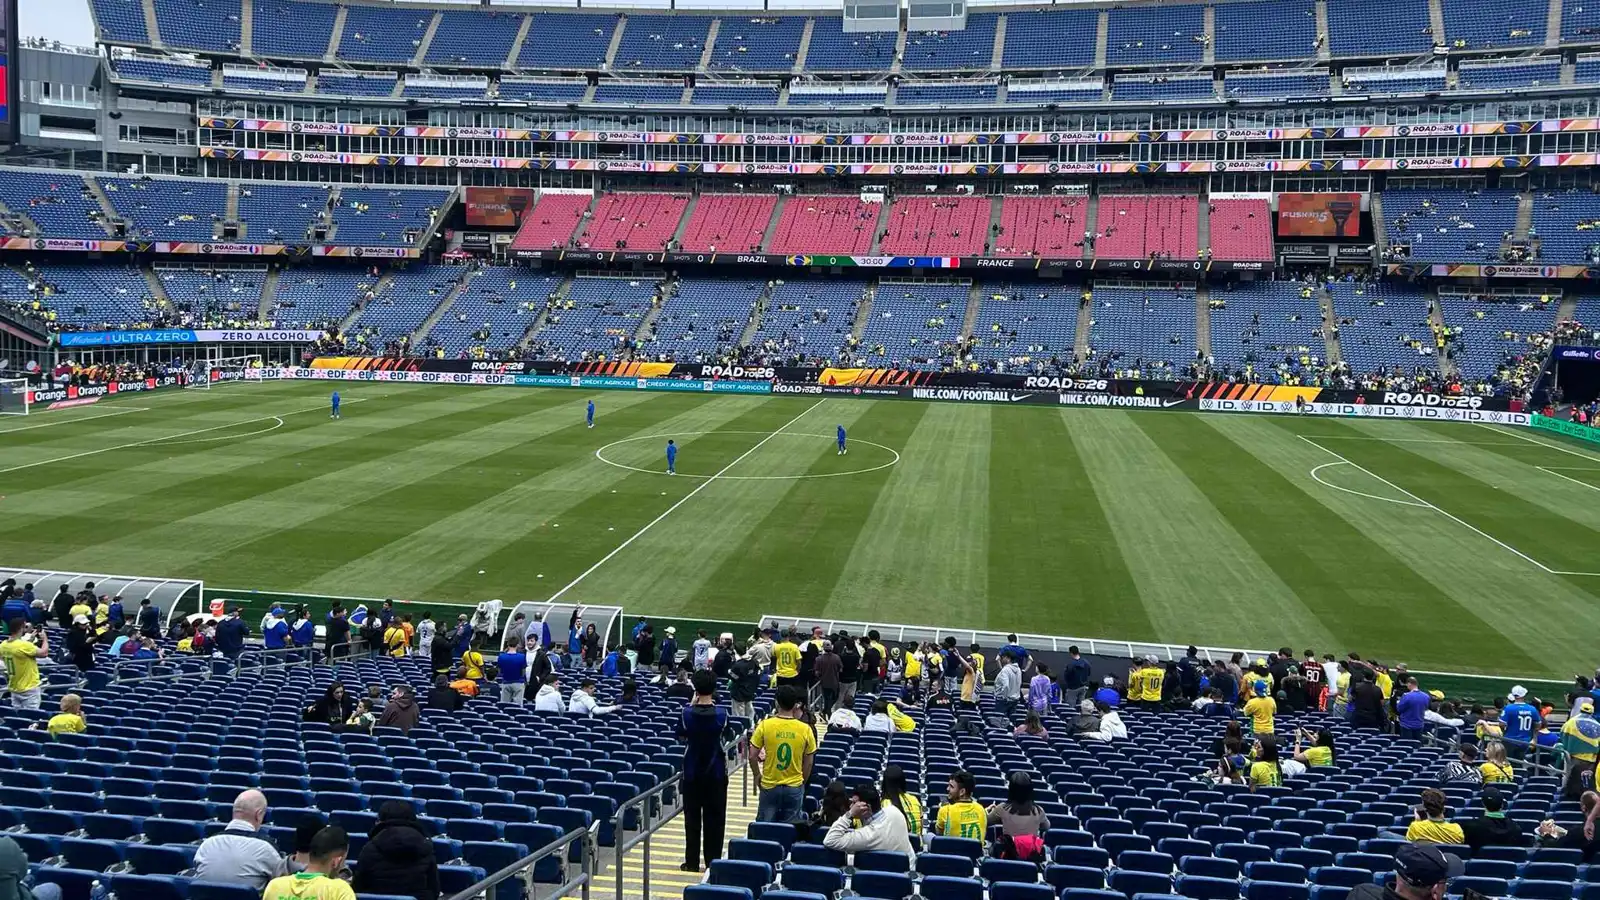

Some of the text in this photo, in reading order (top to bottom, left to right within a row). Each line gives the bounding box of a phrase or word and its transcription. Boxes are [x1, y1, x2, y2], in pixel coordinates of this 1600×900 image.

[1076, 260, 1082, 268] 0
[1133, 261, 1140, 269] 0
[1193, 261, 1200, 270] 0
[112, 333, 152, 342] ULTRA
[156, 332, 190, 341] ZERO
[219, 371, 244, 380] Orange
[35, 390, 66, 401] Orange
[78, 385, 107, 396] Orange
[913, 389, 1009, 401] NIKE.COM/FOOTBALL
[1060, 394, 1161, 407] NIKE.COM/FOOTBALL
[1218, 401, 1237, 410] ID.
[1257, 402, 1276, 411] ID.
[1338, 405, 1356, 414] ID.
[1378, 406, 1398, 415] ID.
[1420, 408, 1440, 417] ID.
[1462, 410, 1484, 420] ID.
[1508, 414, 1529, 424] ID.
[782, 652, 791, 665] 10
[1306, 670, 1320, 682] 80
[1150, 677, 1159, 689] 10
[1518, 716, 1532, 730] 10
[776, 742, 792, 771] 9
